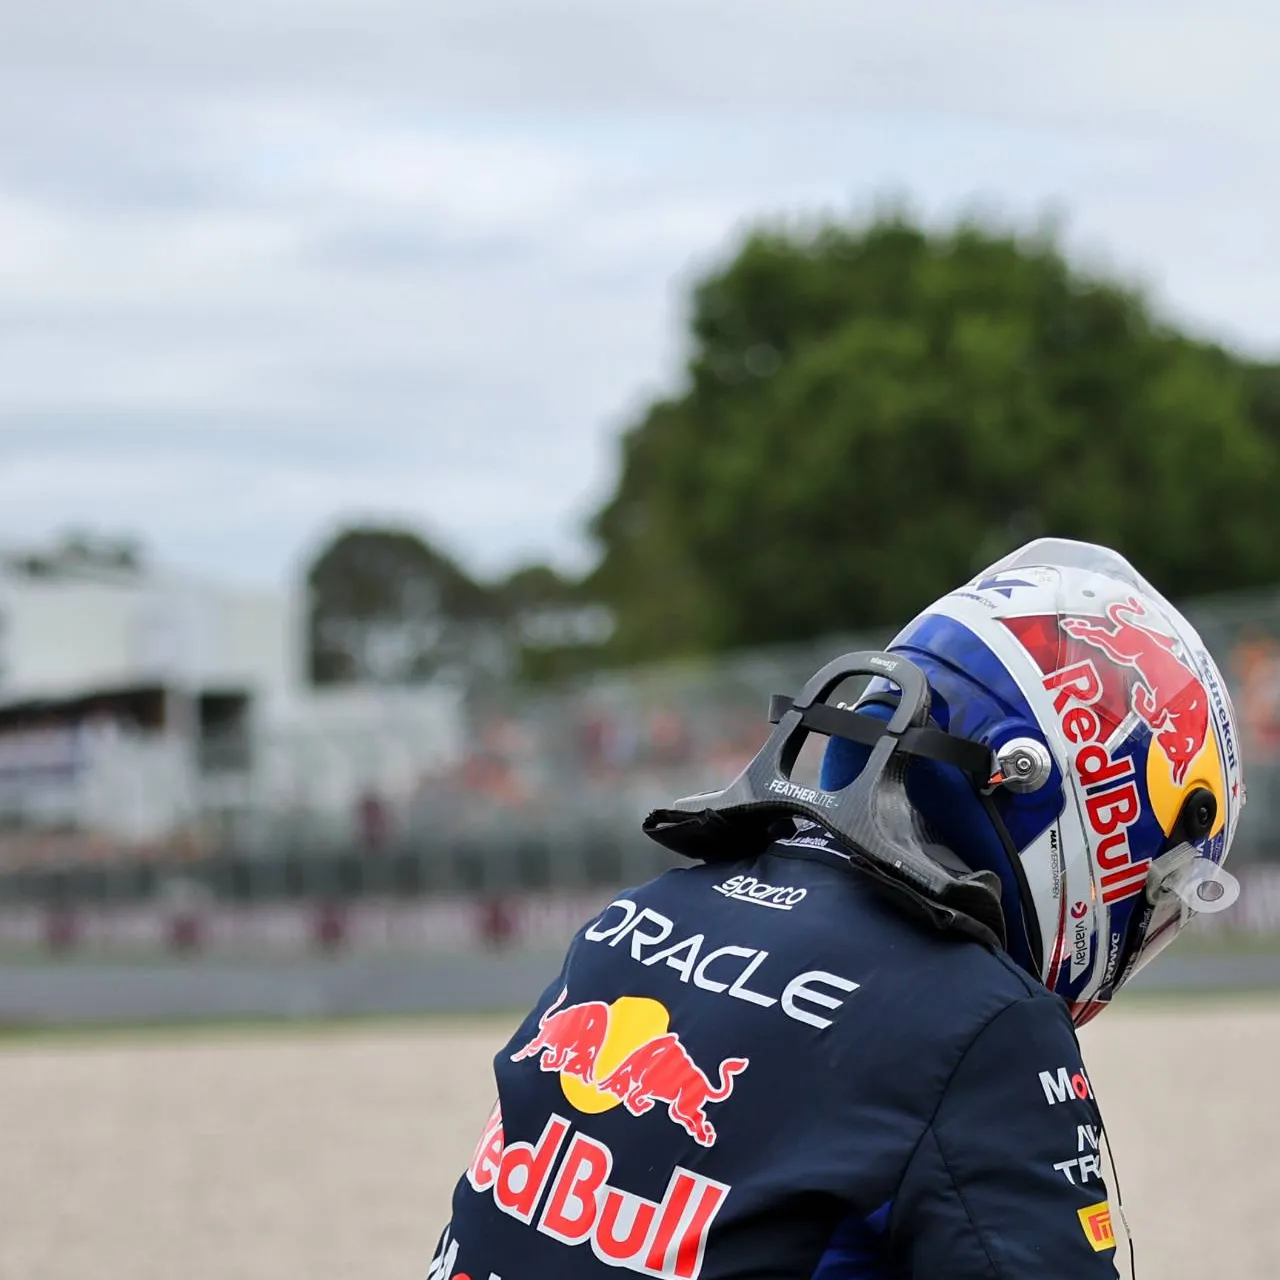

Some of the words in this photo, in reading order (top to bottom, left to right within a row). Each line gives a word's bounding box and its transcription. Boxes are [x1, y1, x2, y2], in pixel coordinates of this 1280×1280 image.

[1041, 659, 1136, 787] Red
[769, 779, 836, 809] FEATHERLITE
[1050, 829, 1059, 849] MAX
[1084, 779, 1153, 905] Bull
[713, 873, 808, 911] sparco
[584, 898, 861, 1030] ORACLE
[1074, 920, 1086, 967] viaplay
